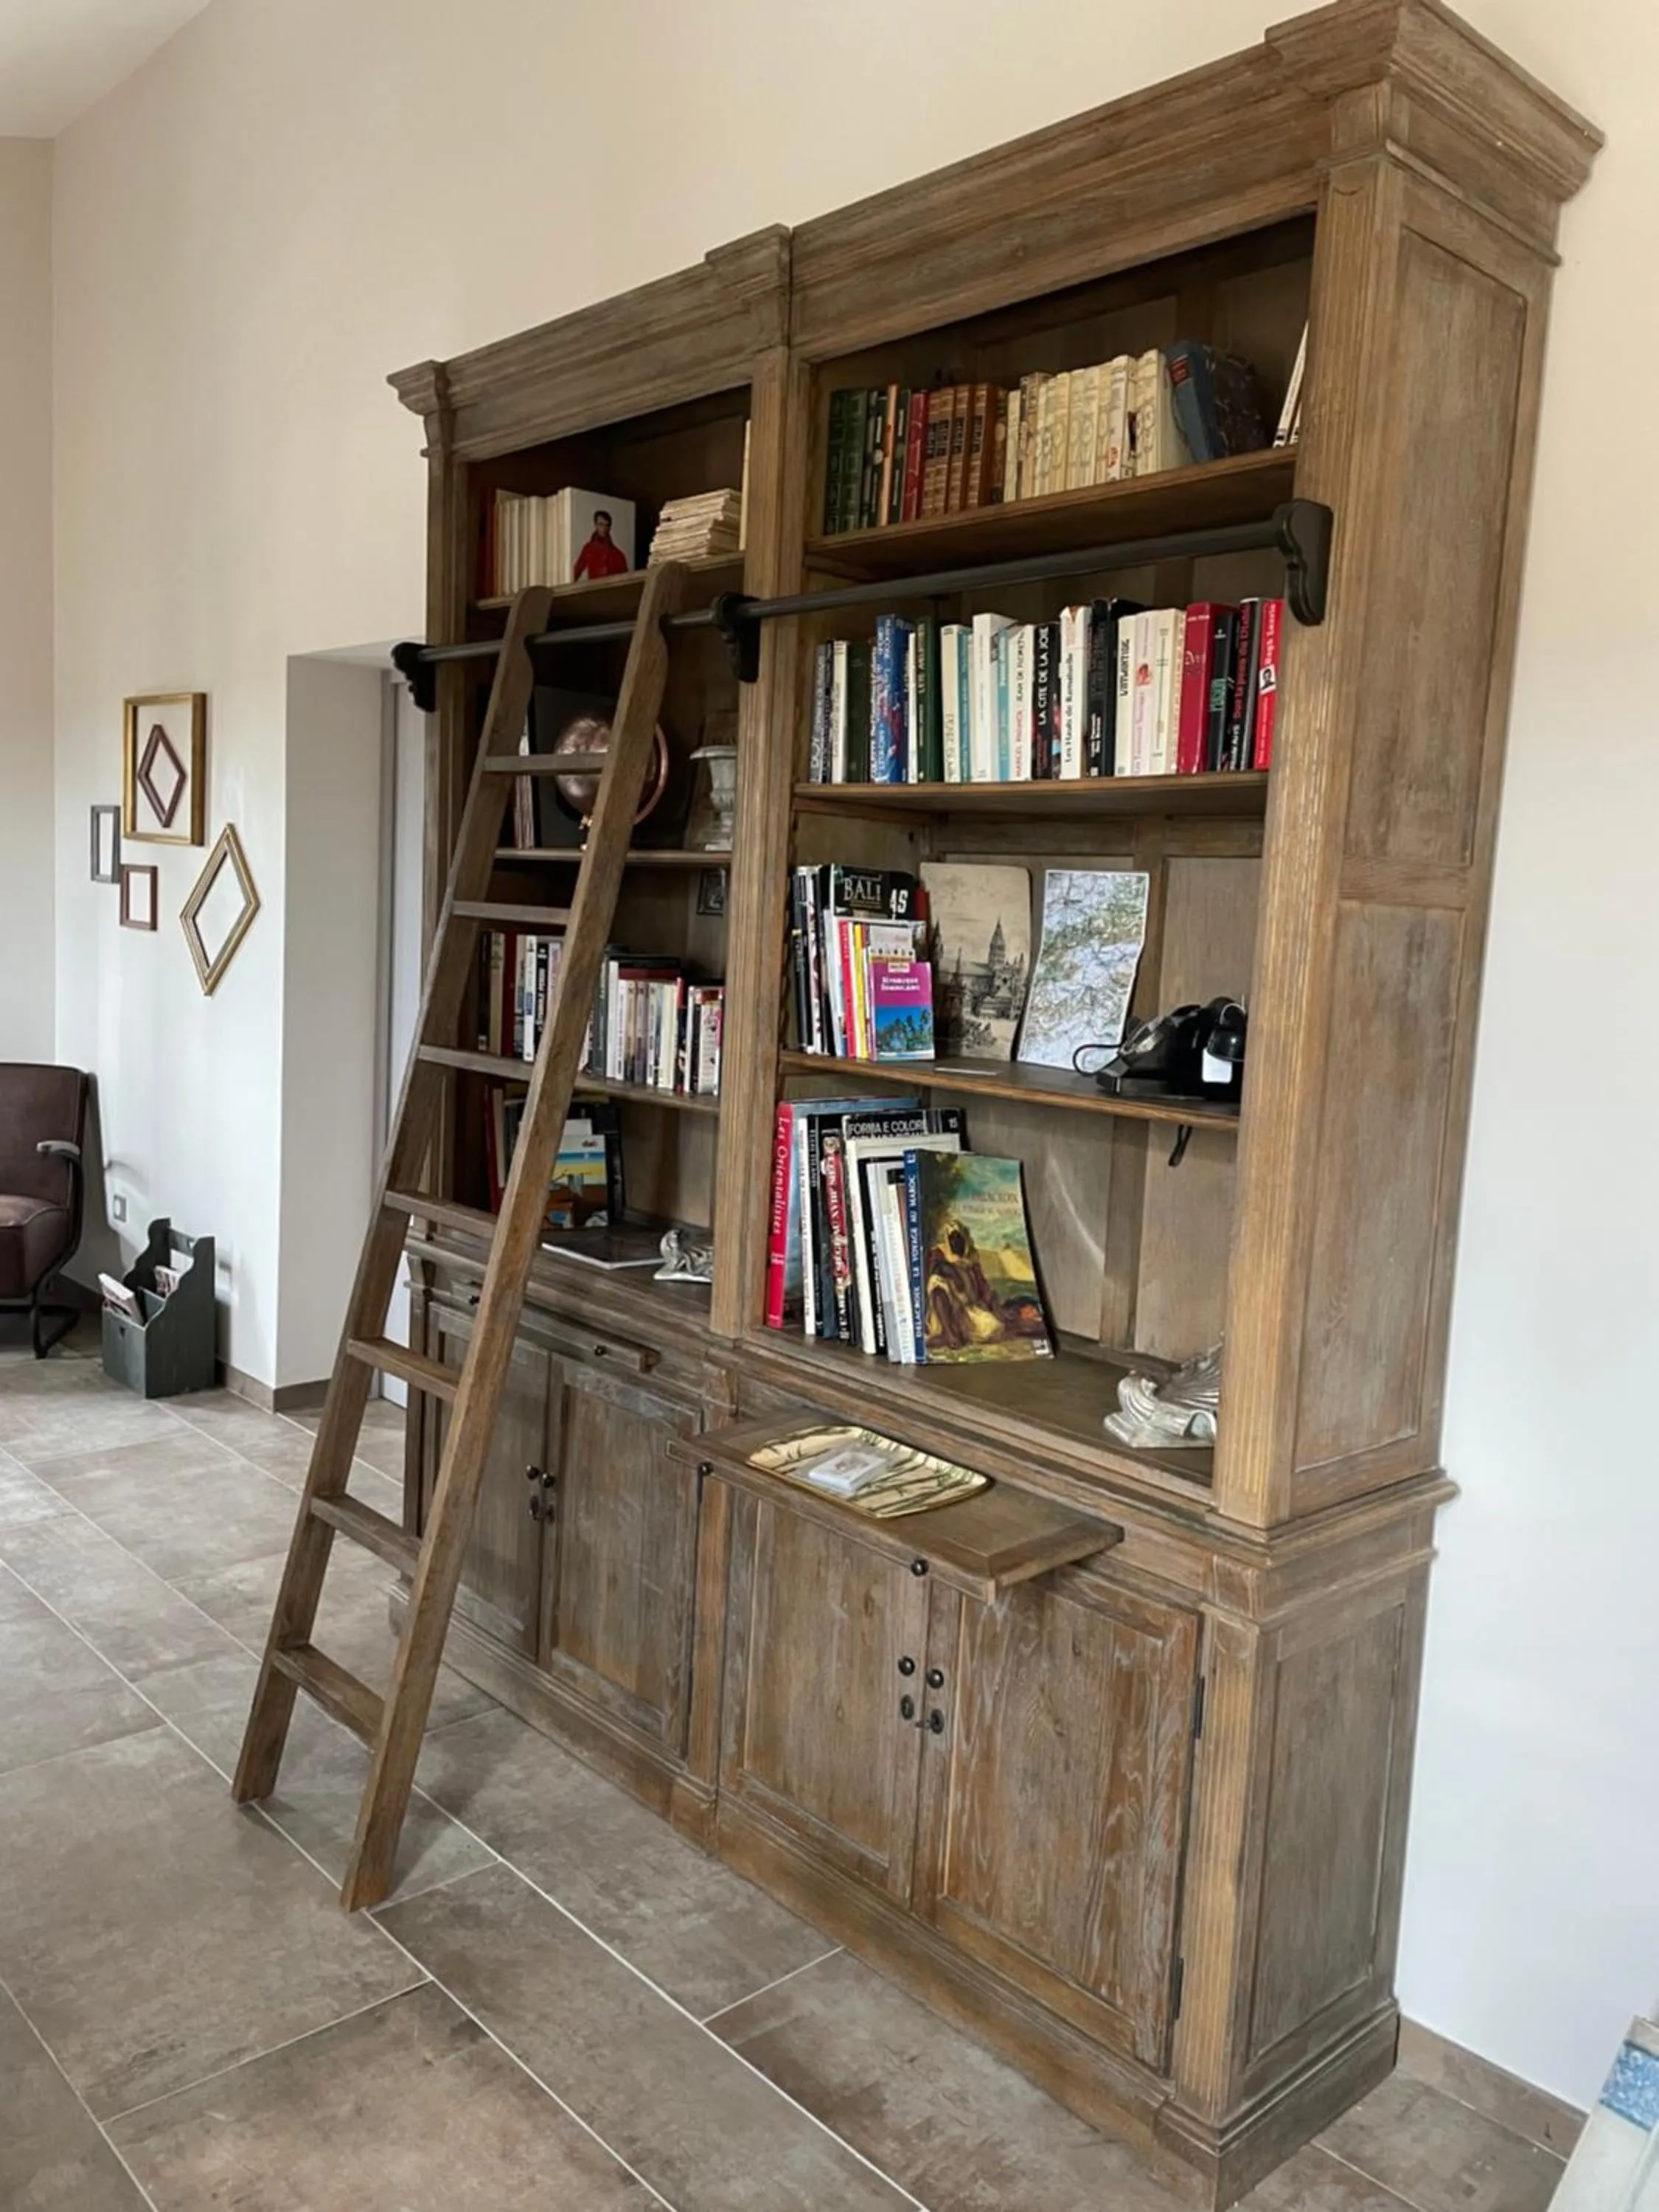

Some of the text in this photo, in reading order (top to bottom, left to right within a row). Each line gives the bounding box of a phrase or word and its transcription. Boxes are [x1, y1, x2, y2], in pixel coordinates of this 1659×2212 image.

[1039, 653, 1048, 667] LA
[1038, 669, 1048, 683] DE
[1037, 710, 1046, 726] LA
[843, 877, 882, 902] BALI
[777, 1116, 790, 1141] Les
[848, 1121, 882, 1135] FORMA
[883, 1121, 890, 1133] E
[772, 1145, 789, 1235] Orientalistes
[908, 1174, 917, 1207] MAROC
[909, 1210, 918, 1223] AU
[909, 1227, 919, 1263] VOYAGE
[913, 1286, 922, 1338] DELACROIX
